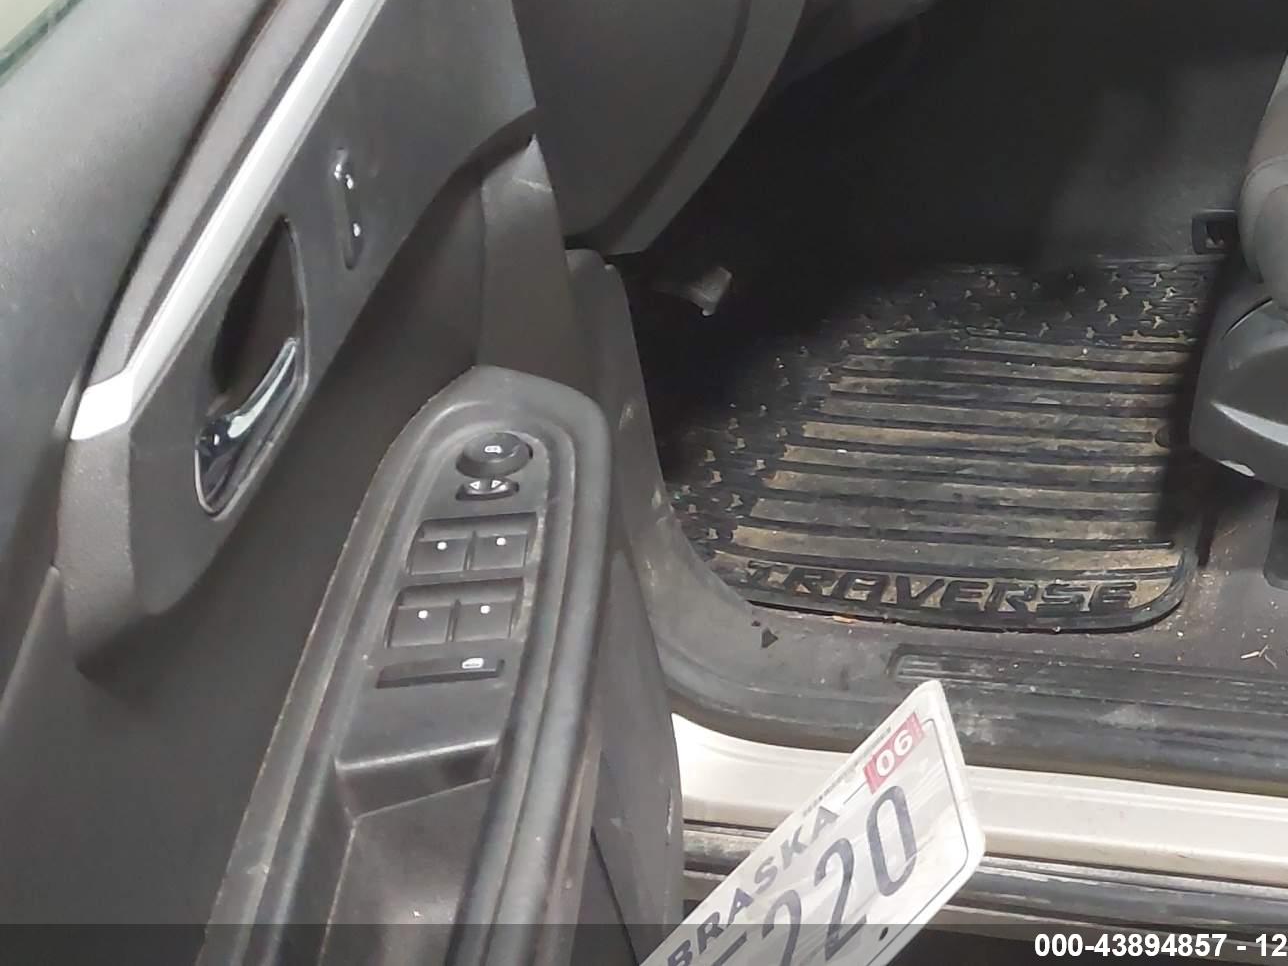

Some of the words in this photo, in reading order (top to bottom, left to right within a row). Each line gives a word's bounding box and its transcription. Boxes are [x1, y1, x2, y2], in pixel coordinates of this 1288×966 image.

[746, 559, 1138, 614] TRAVERSE
[875, 729, 913, 778] 06
[712, 784, 919, 966] 220
